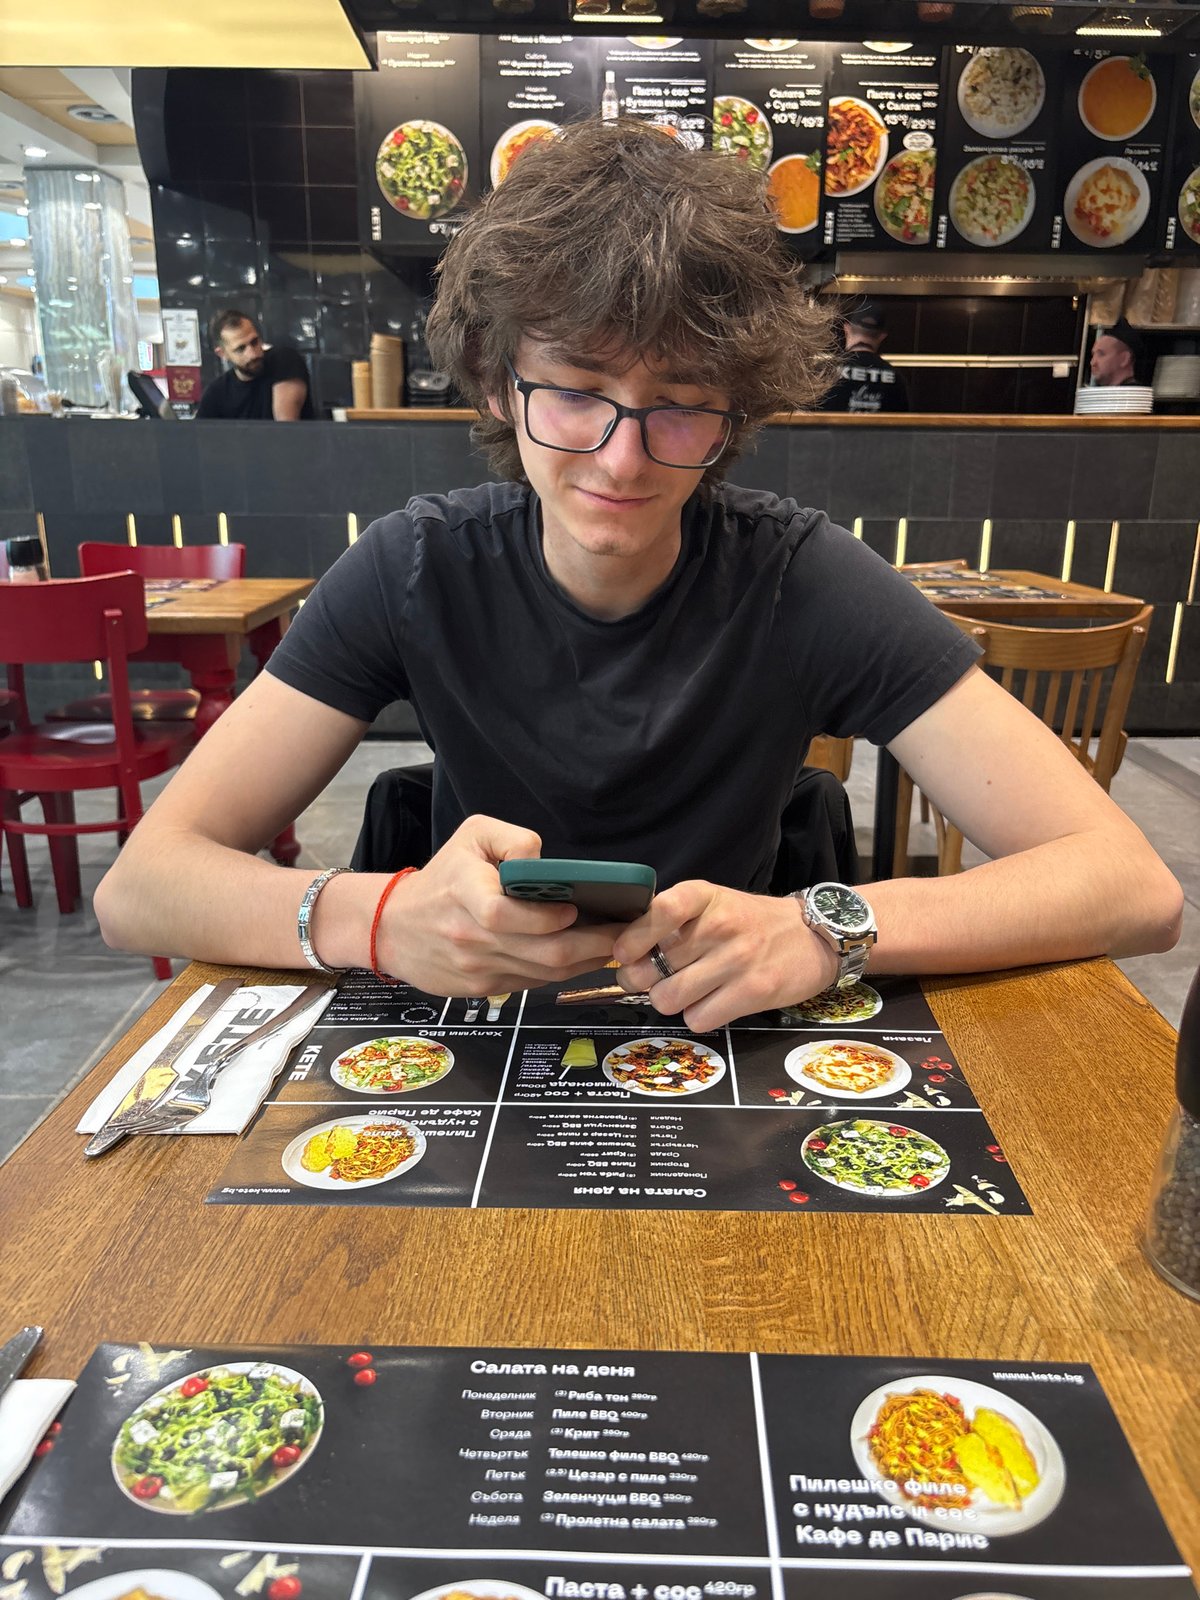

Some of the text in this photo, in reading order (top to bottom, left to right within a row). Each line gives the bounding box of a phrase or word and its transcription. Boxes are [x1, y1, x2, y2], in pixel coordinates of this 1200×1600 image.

[769, 88, 806, 98] Салата
[772, 100, 799, 112] Супа
[886, 100, 922, 110] Салата
[371, 207, 381, 241] KETE
[824, 211, 835, 245] KETE
[936, 215, 948, 248] KETE
[1051, 216, 1063, 248] KETE
[1165, 216, 1176, 250] KETE
[839, 367, 896, 384] KETE
[882, 1034, 933, 1044] Лазаня
[288, 1045, 322, 1082] KETE
[368, 1108, 482, 1117] Кафе де Парис
[408, 1130, 476, 1138] Пилешко
[586, 1160, 608, 1168] BBQ
[221, 1186, 291, 1194] www.kete.bg
[573, 1186, 707, 1198] Салата на деня
[470, 1360, 636, 1378] Салата на деня
[992, 1370, 1086, 1386] www.kete.bg
[461, 1390, 537, 1401] Понеделник
[568, 1390, 603, 1402] Риба
[605, 1392, 629, 1402] тон
[480, 1409, 534, 1420] Вторник
[552, 1408, 648, 1422] Пиле BBQ 400гр
[490, 1428, 532, 1440] Сряда
[564, 1428, 600, 1441] Крит
[458, 1448, 529, 1461] Четвъртък
[548, 1448, 710, 1466] Телешко филе BBQ 420гр
[484, 1469, 527, 1481] Петък
[568, 1469, 616, 1484] Цезар
[618, 1472, 628, 1482] с
[630, 1472, 668, 1484] пиле
[788, 1474, 967, 1497] Пилешко филе
[470, 1490, 524, 1503] Събота
[542, 1490, 628, 1506] Зеленчуци
[629, 1492, 663, 1508] BBQ
[792, 1501, 979, 1521] с нудълс и сос
[468, 1513, 521, 1527] Неделя
[555, 1514, 630, 1530] Пролетна
[631, 1516, 686, 1530] салата
[796, 1524, 990, 1552] Кафе де Парис
[544, 1576, 757, 1600] Паста + сос 420гр
